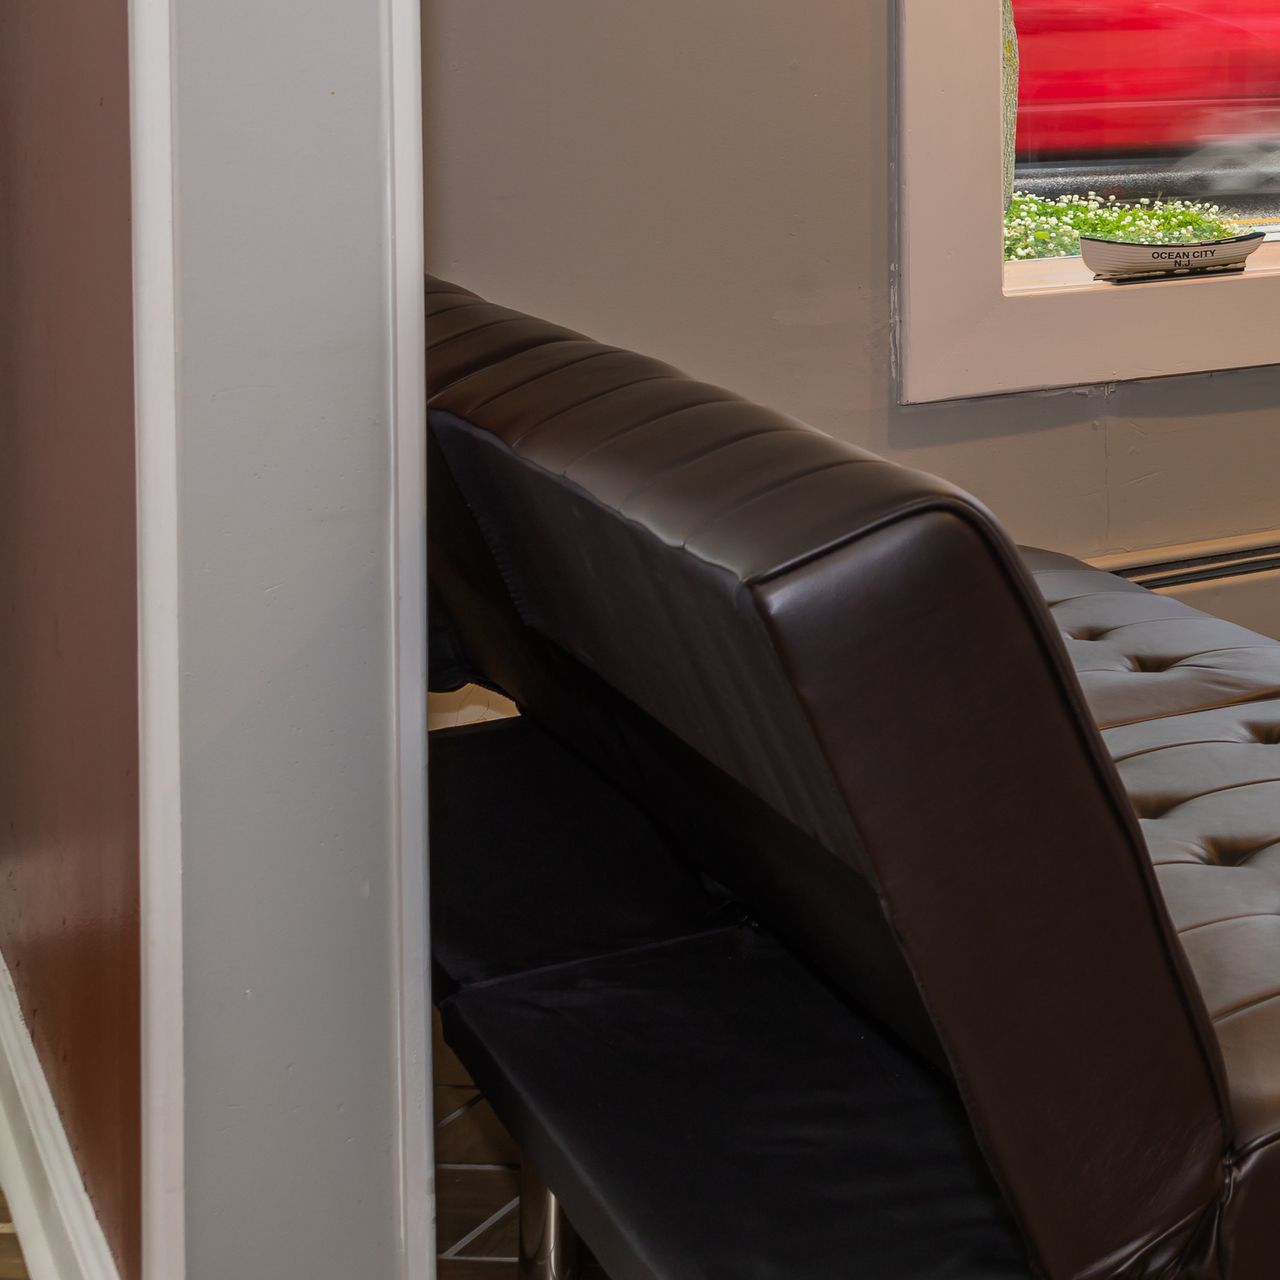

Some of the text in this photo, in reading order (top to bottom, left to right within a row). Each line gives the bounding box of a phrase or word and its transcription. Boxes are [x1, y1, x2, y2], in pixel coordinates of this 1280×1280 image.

[1151, 249, 1216, 260] OCEAN CITY
[1174, 259, 1194, 268] N.J.
